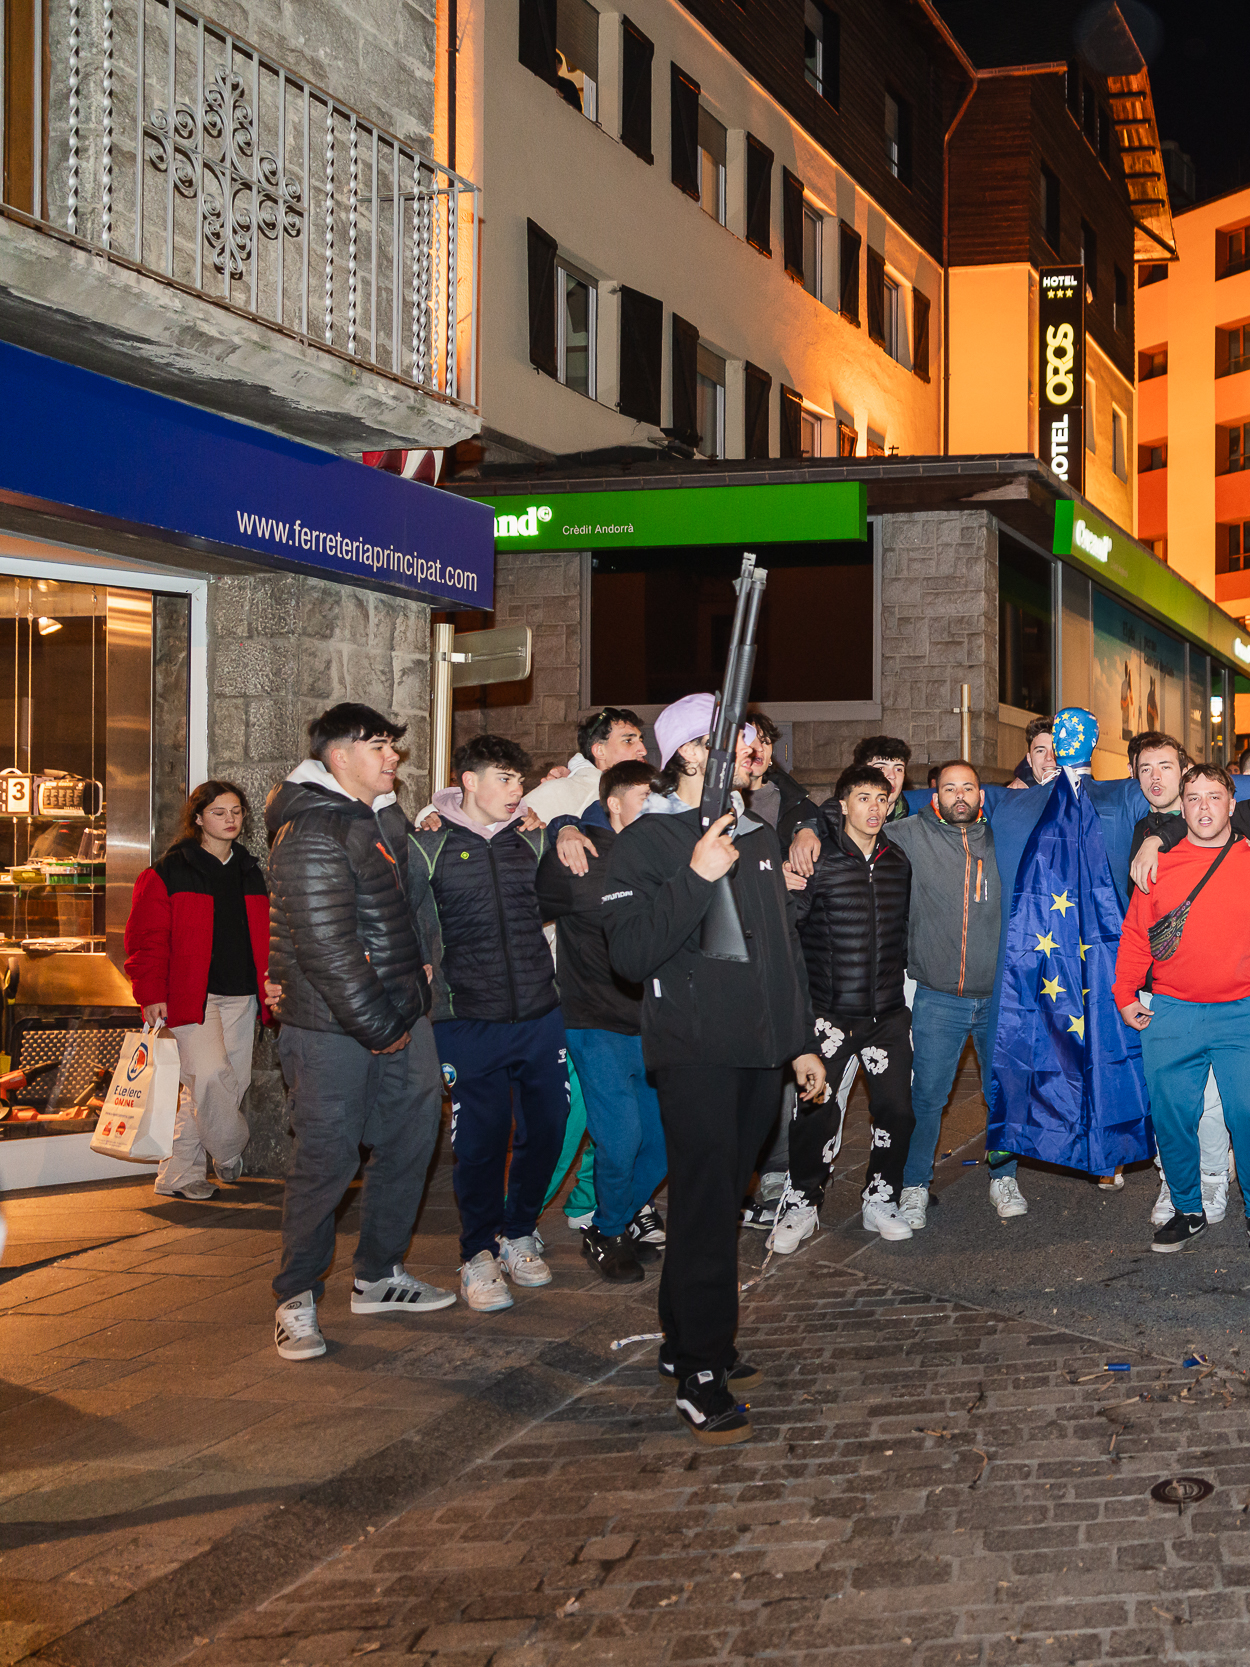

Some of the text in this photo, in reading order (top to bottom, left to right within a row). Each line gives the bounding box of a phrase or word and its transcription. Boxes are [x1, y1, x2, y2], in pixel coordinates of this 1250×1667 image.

[1042, 275, 1078, 288] HOTEL
[562, 523, 634, 535] Crèdit Andorrà
[236, 510, 478, 592] www.ferreteriaprincipat.com
